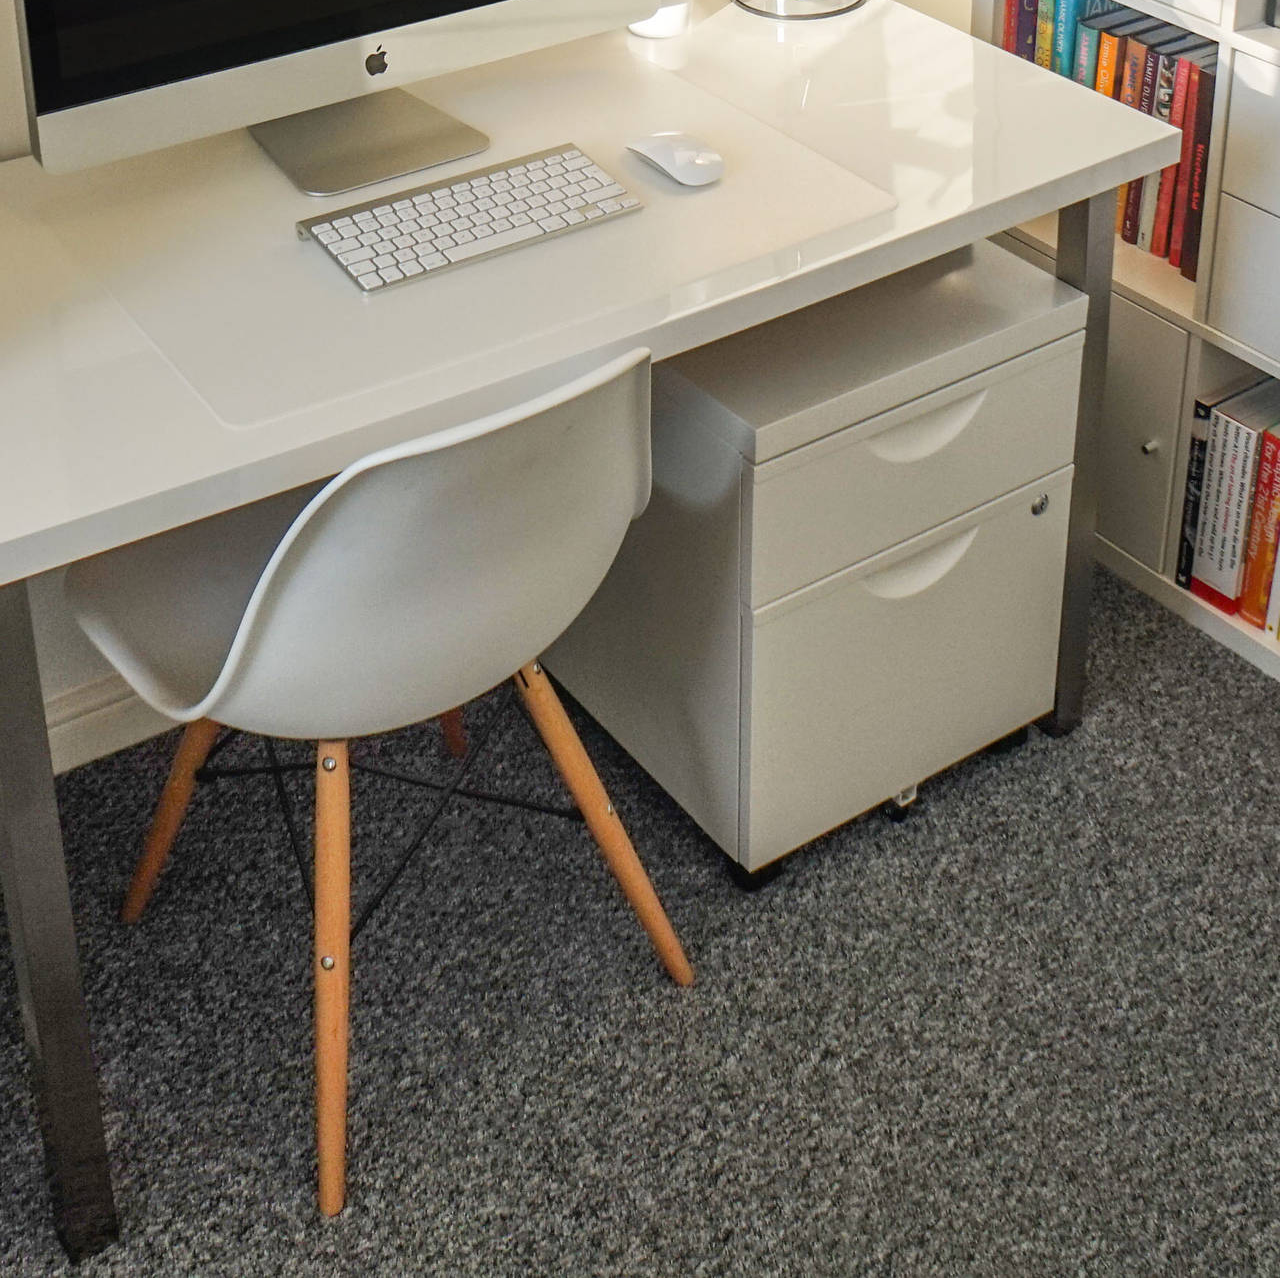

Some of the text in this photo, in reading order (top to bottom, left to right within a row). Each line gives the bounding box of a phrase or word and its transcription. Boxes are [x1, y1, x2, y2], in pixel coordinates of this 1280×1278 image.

[1055, 22, 1064, 52] OLIVER
[1078, 33, 1091, 65] JAMIE
[1101, 39, 1112, 66] Jamie
[1125, 56, 1138, 89] JAMIE
[1144, 54, 1153, 82] JAMIE
[1246, 441, 1276, 558] for the 21st Century
